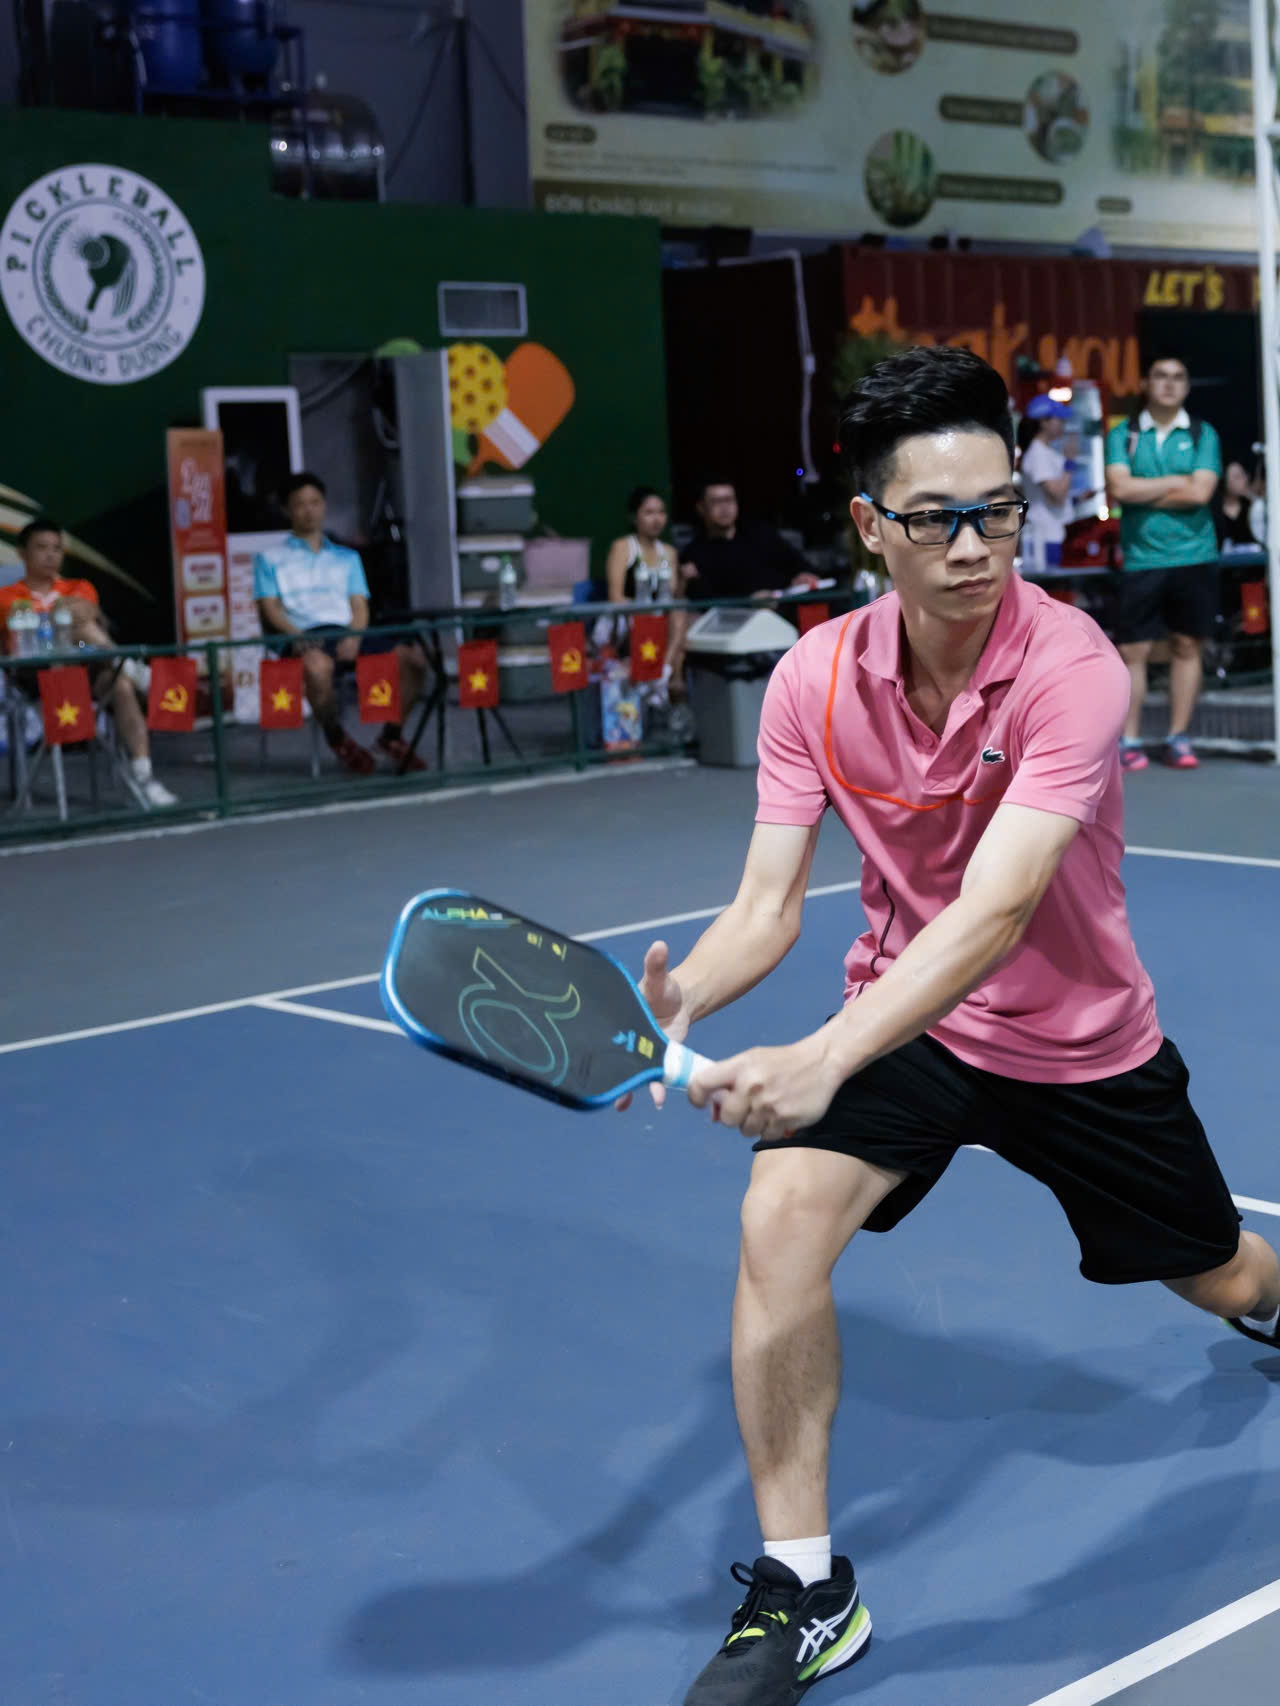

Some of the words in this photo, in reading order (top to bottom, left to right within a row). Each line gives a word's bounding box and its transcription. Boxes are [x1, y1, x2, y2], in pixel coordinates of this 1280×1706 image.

[6, 173, 195, 276] PICKLEBALL
[1143, 264, 1225, 310] LET'S
[421, 907, 489, 920] ALPHA
